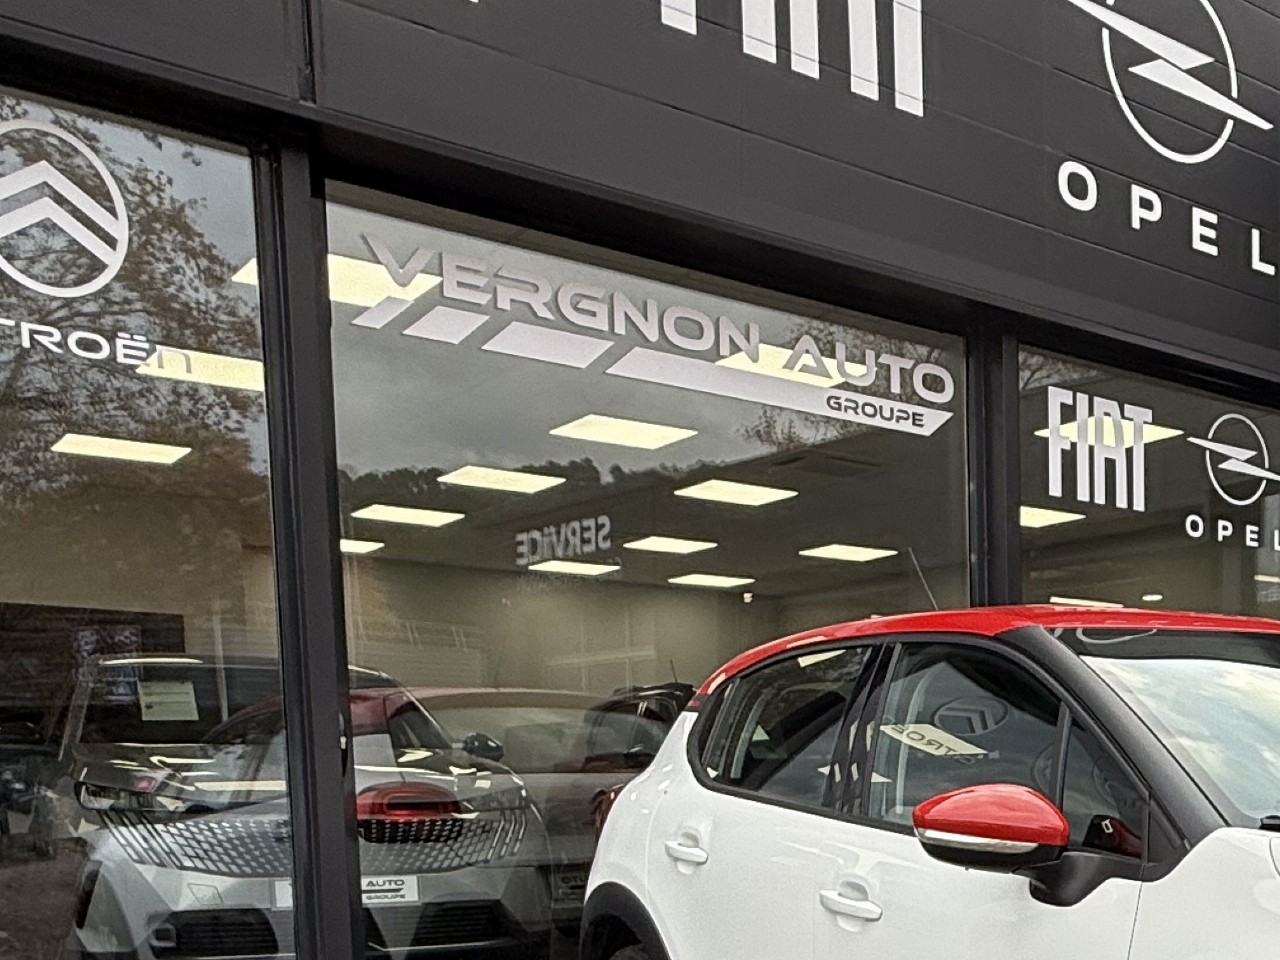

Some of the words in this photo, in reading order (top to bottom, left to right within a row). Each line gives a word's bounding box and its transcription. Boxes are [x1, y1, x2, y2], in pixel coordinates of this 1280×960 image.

[1058, 160, 1276, 276] OPEL
[362, 232, 761, 364] VERGNON
[781, 332, 956, 405] AUTO
[826, 394, 926, 430] GROUPE
[1046, 384, 1154, 513] FIAT
[366, 878, 406, 888] AUTO
